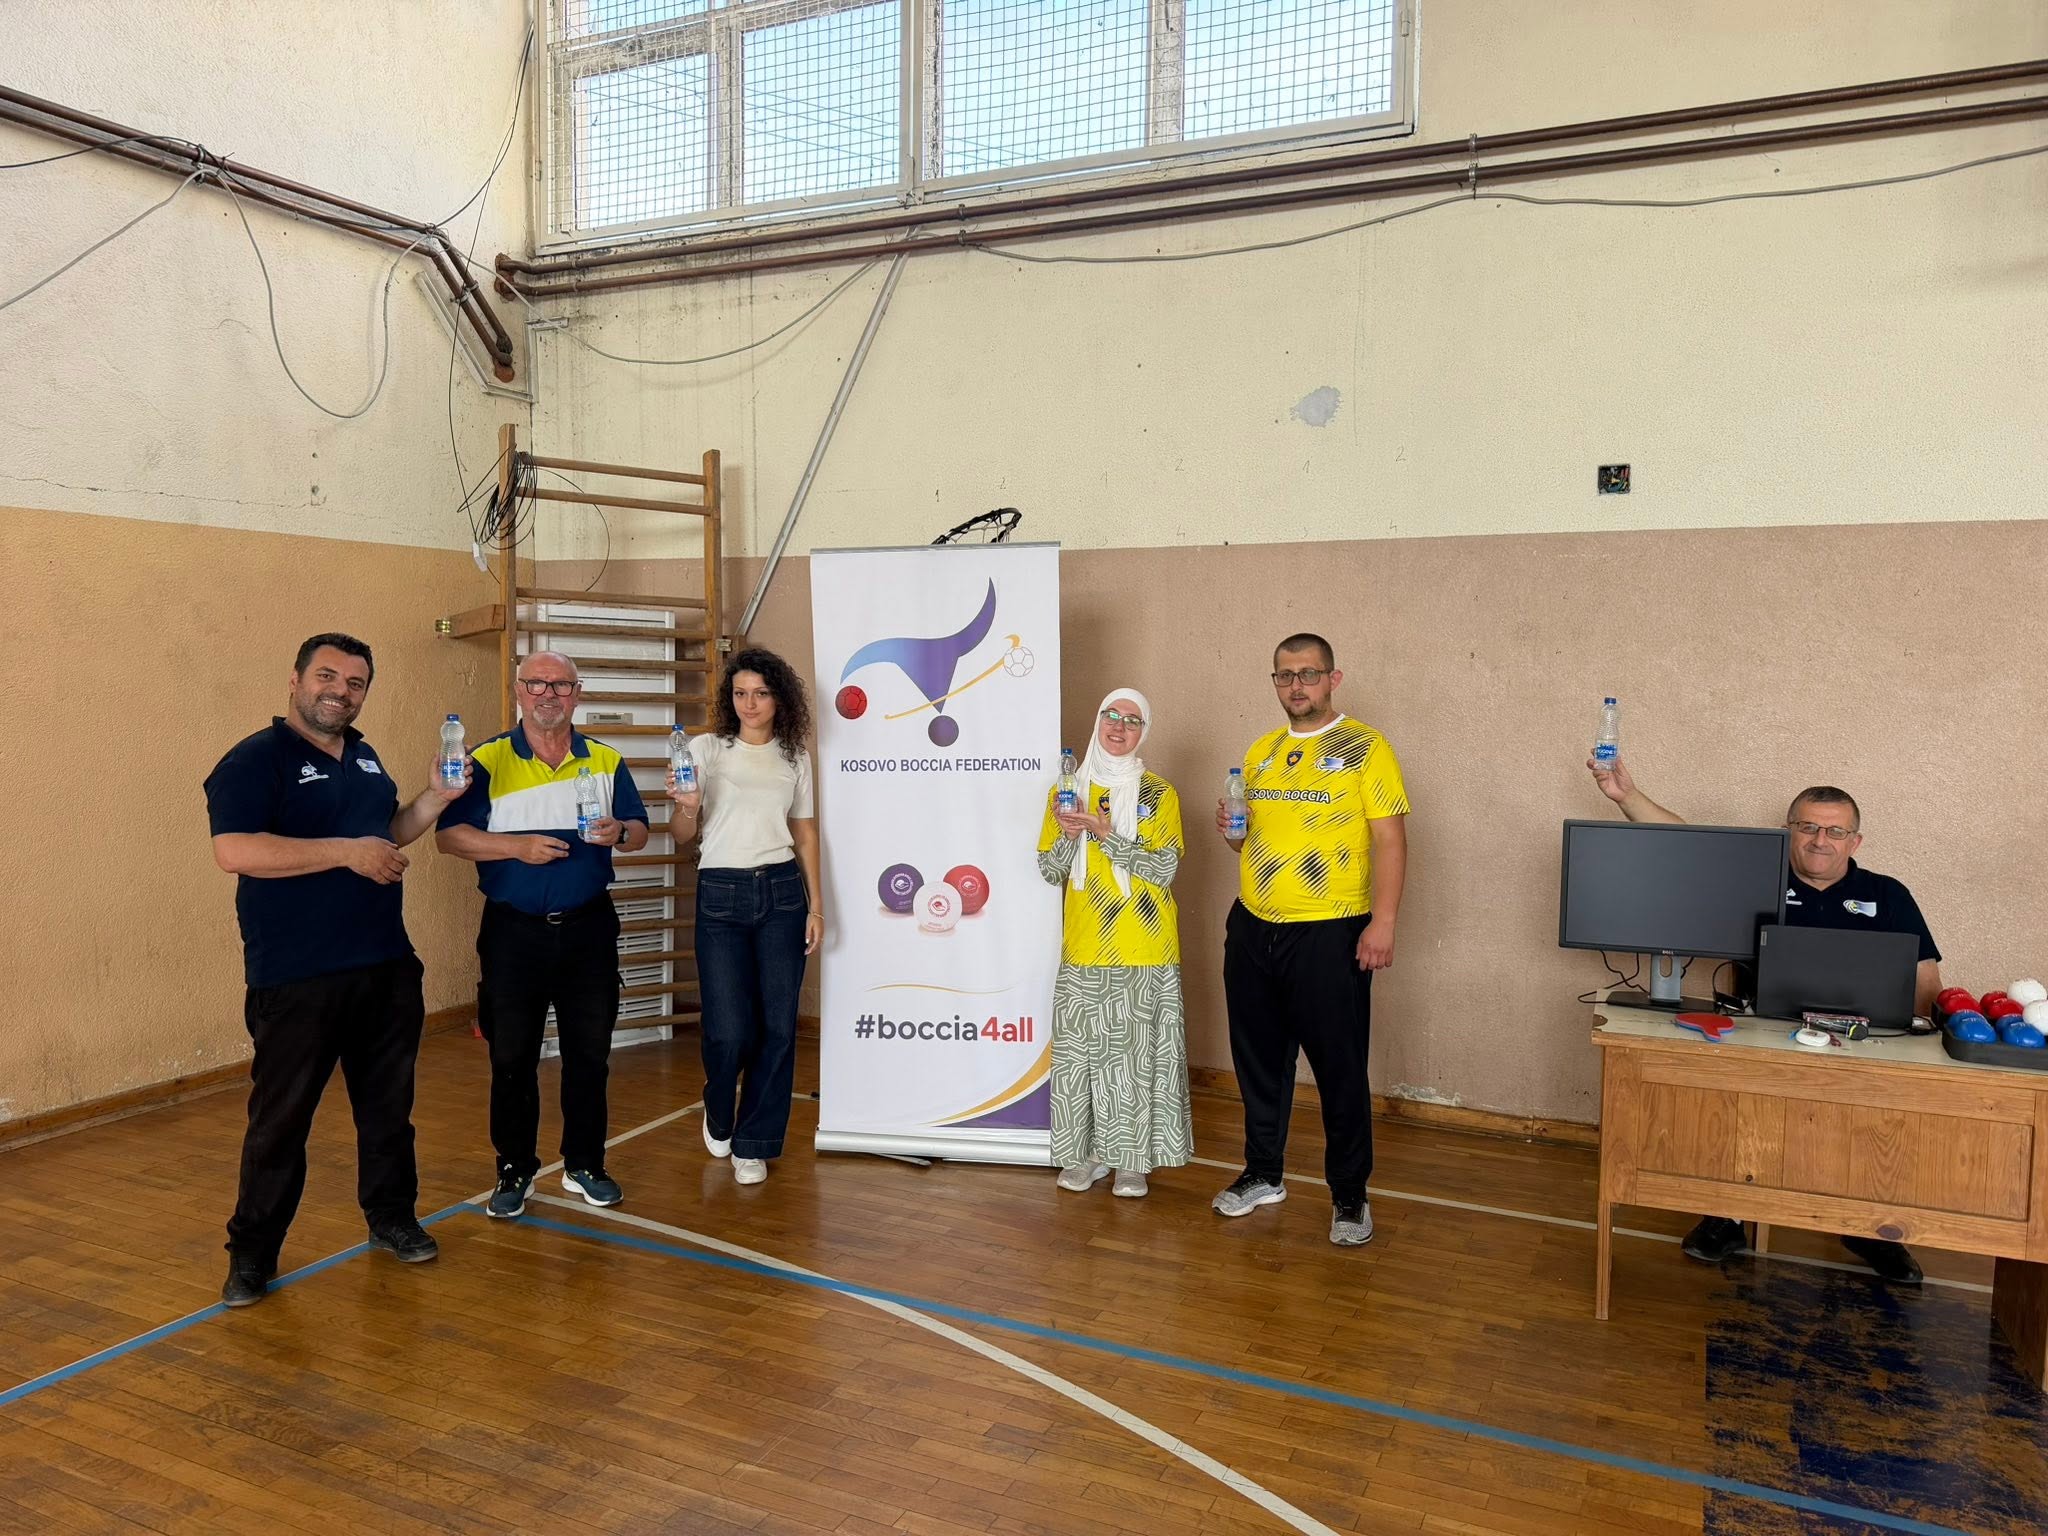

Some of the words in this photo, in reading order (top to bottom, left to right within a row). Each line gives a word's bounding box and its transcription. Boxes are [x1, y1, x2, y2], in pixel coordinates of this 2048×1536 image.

[1394, 446, 1406, 462] 2
[840, 759, 897, 772] KOSOVO
[900, 759, 953, 771] BOCCIA
[955, 758, 1041, 771] FEDERATION
[1247, 789, 1282, 800] OSOVO
[1283, 790, 1331, 804] BOCCIA
[854, 1014, 1033, 1042] #boccia4all
